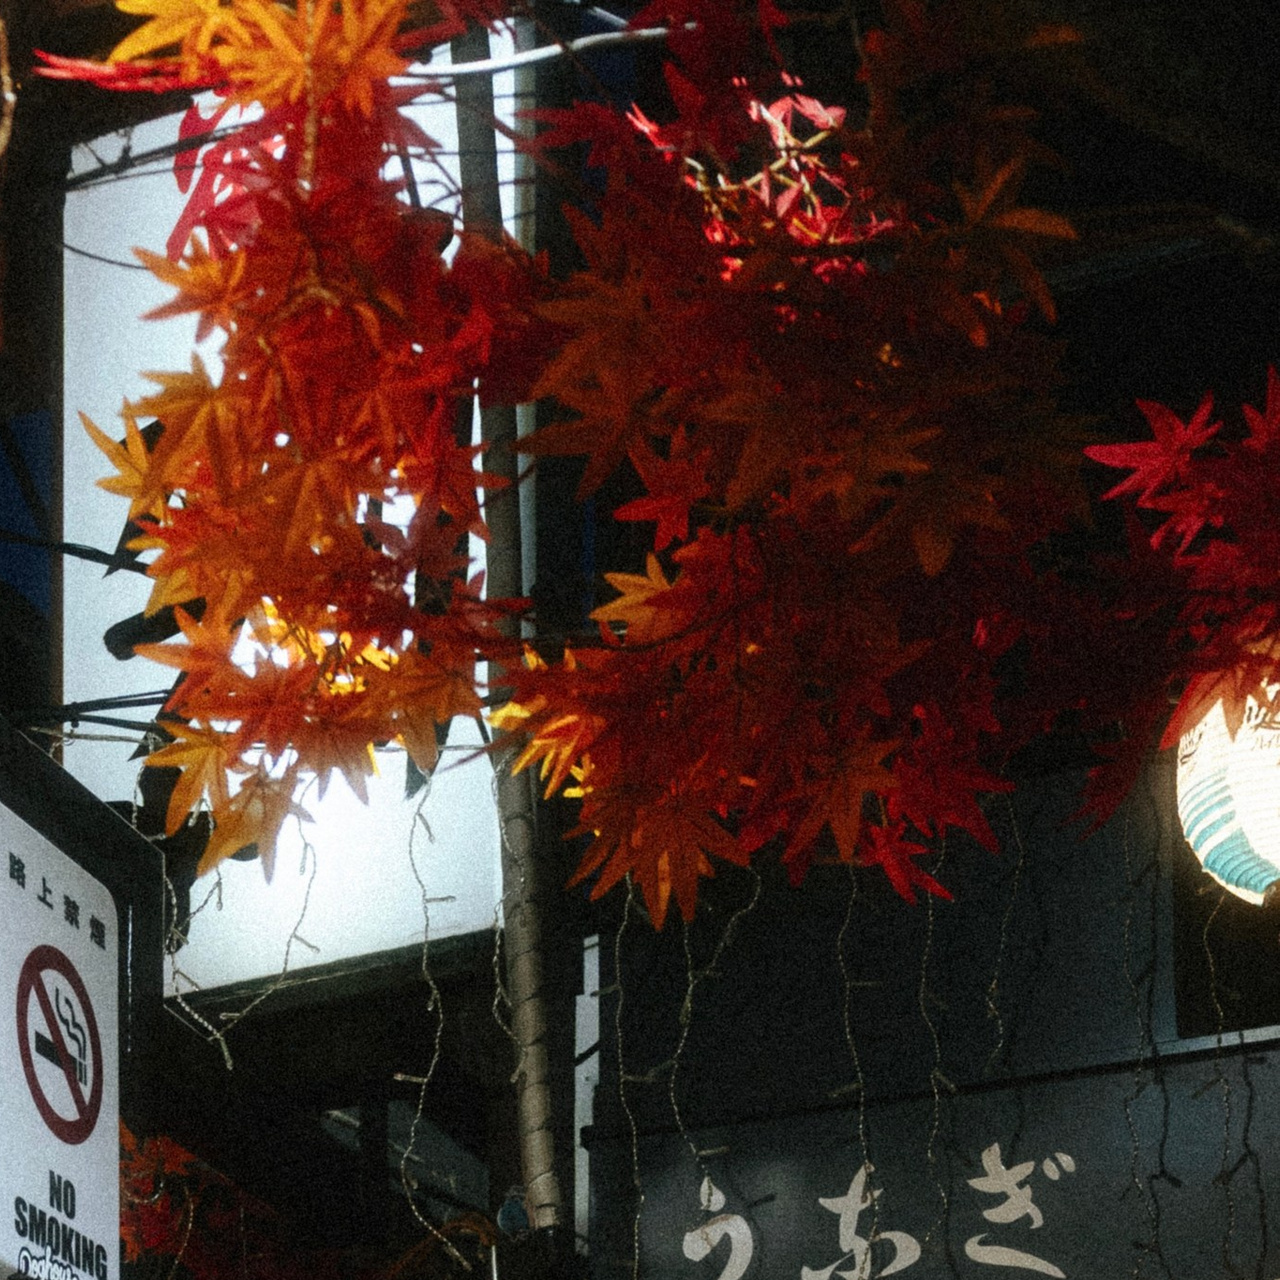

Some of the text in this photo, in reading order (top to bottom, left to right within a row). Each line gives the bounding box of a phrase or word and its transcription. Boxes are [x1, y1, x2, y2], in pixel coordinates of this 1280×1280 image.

[8, 850, 106, 952] 路上禁煙
[48, 1168, 77, 1221] NO
